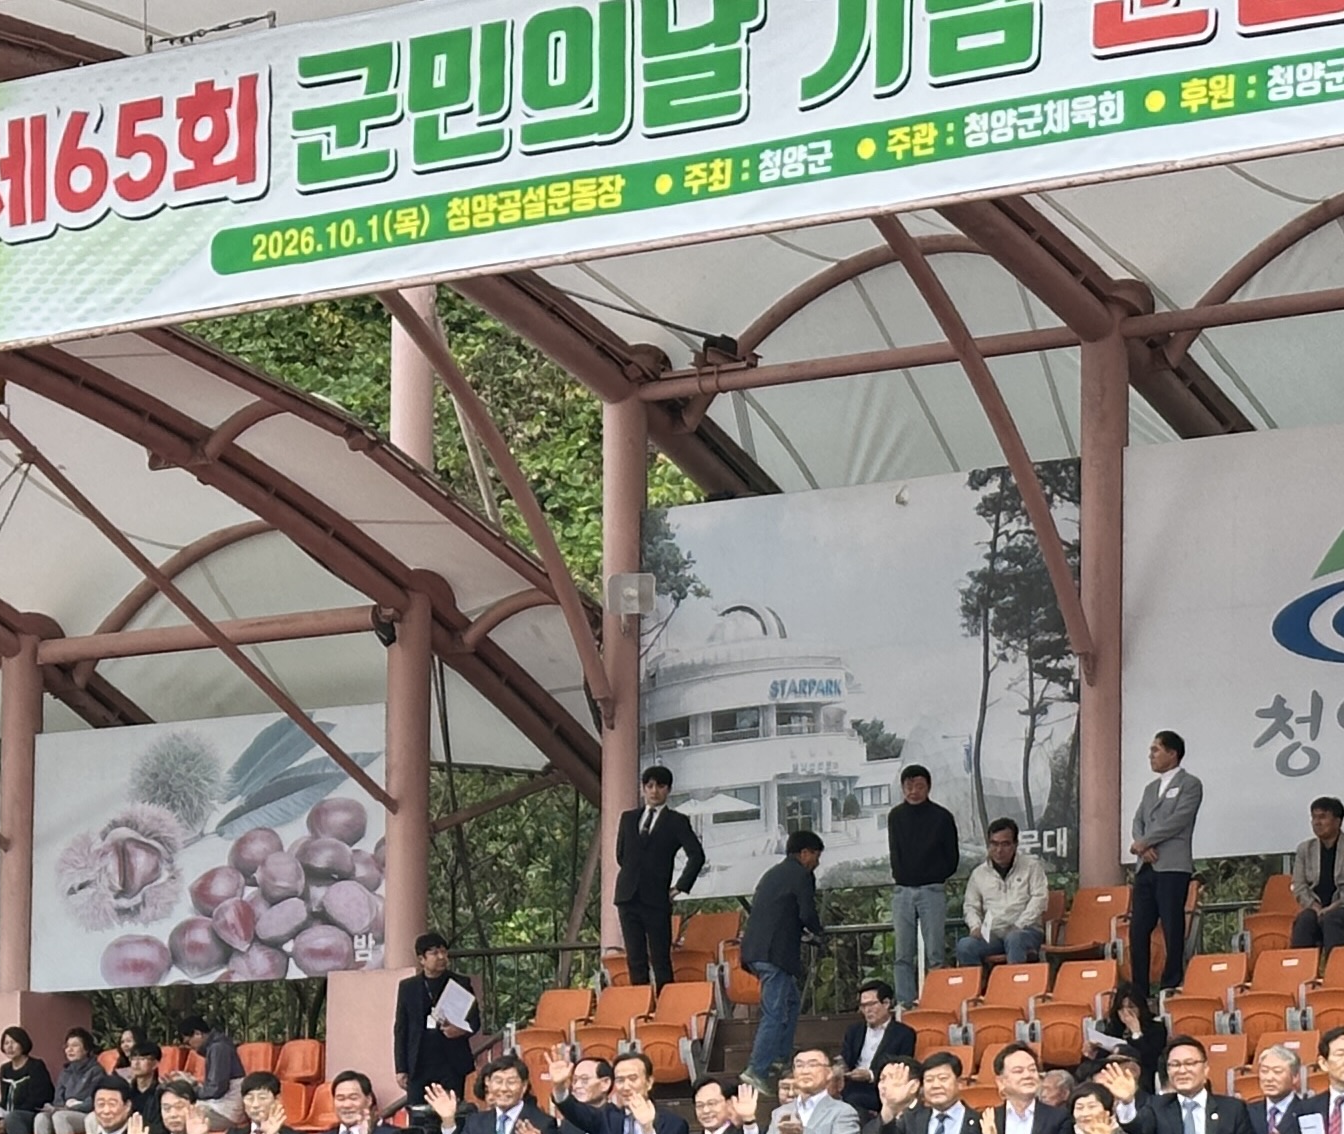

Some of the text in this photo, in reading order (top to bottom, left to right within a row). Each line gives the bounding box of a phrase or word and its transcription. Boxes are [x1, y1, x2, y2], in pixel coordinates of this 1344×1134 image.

[251, 210, 431, 263] 2026.10.1(목)
[446, 174, 626, 233] 청양공설운동장
[684, 157, 732, 196] 주최
[757, 140, 834, 184] 청양군
[886, 122, 938, 161] 주관
[963, 90, 1126, 148] 청양군체육회
[1179, 75, 1237, 113] 후원
[768, 677, 843, 699] STARPARK
[353, 932, 376, 962] 밤
